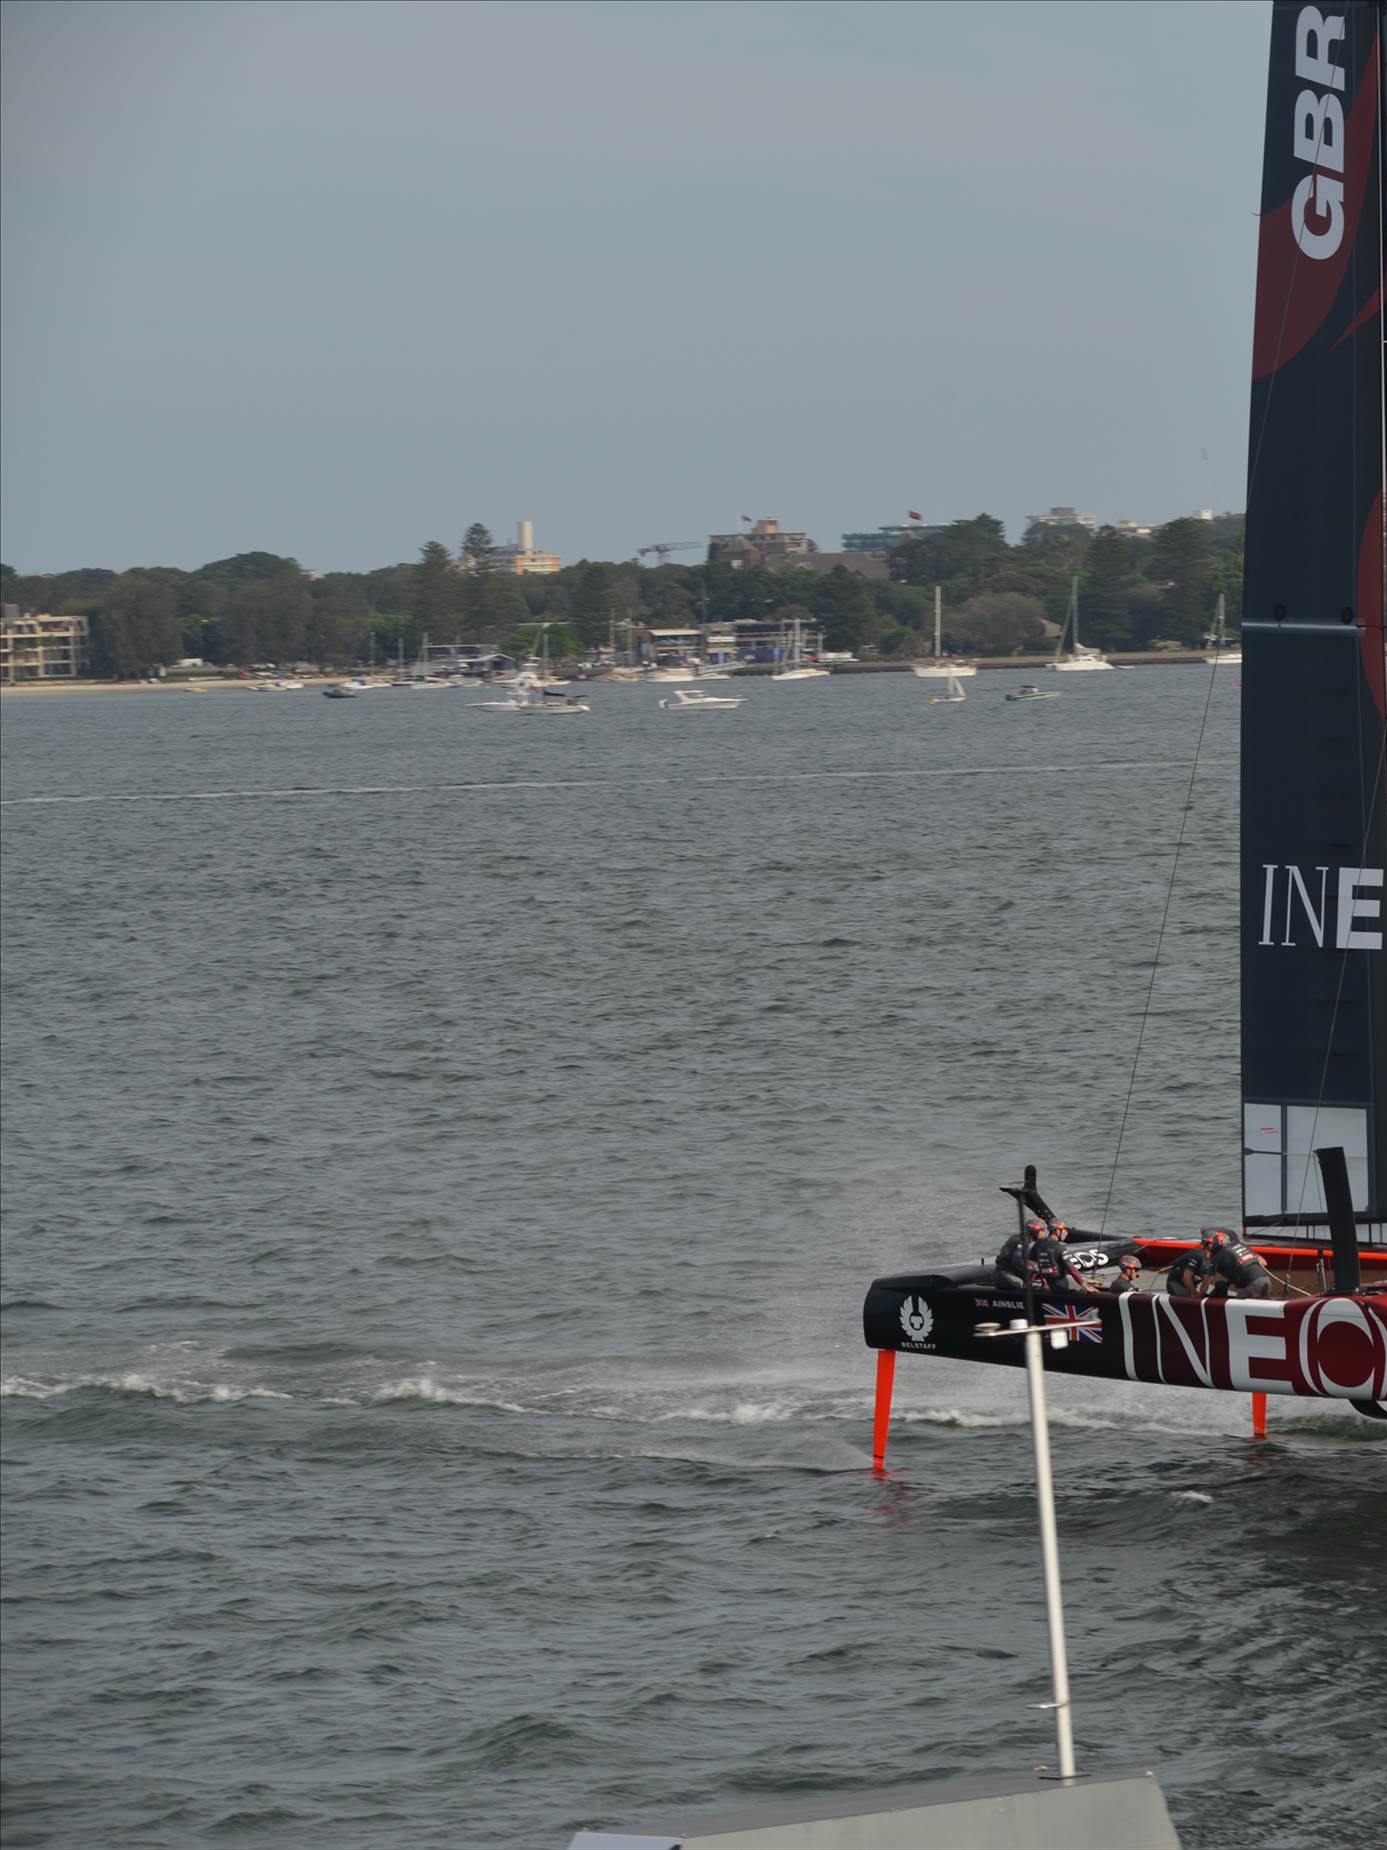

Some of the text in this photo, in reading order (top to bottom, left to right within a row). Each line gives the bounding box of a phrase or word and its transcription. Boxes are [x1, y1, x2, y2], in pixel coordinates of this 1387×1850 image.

[1291, 5, 1345, 260] GBR
[992, 1300, 1025, 1310] AINSLIE
[901, 1342, 936, 1350] BELSTAFF
